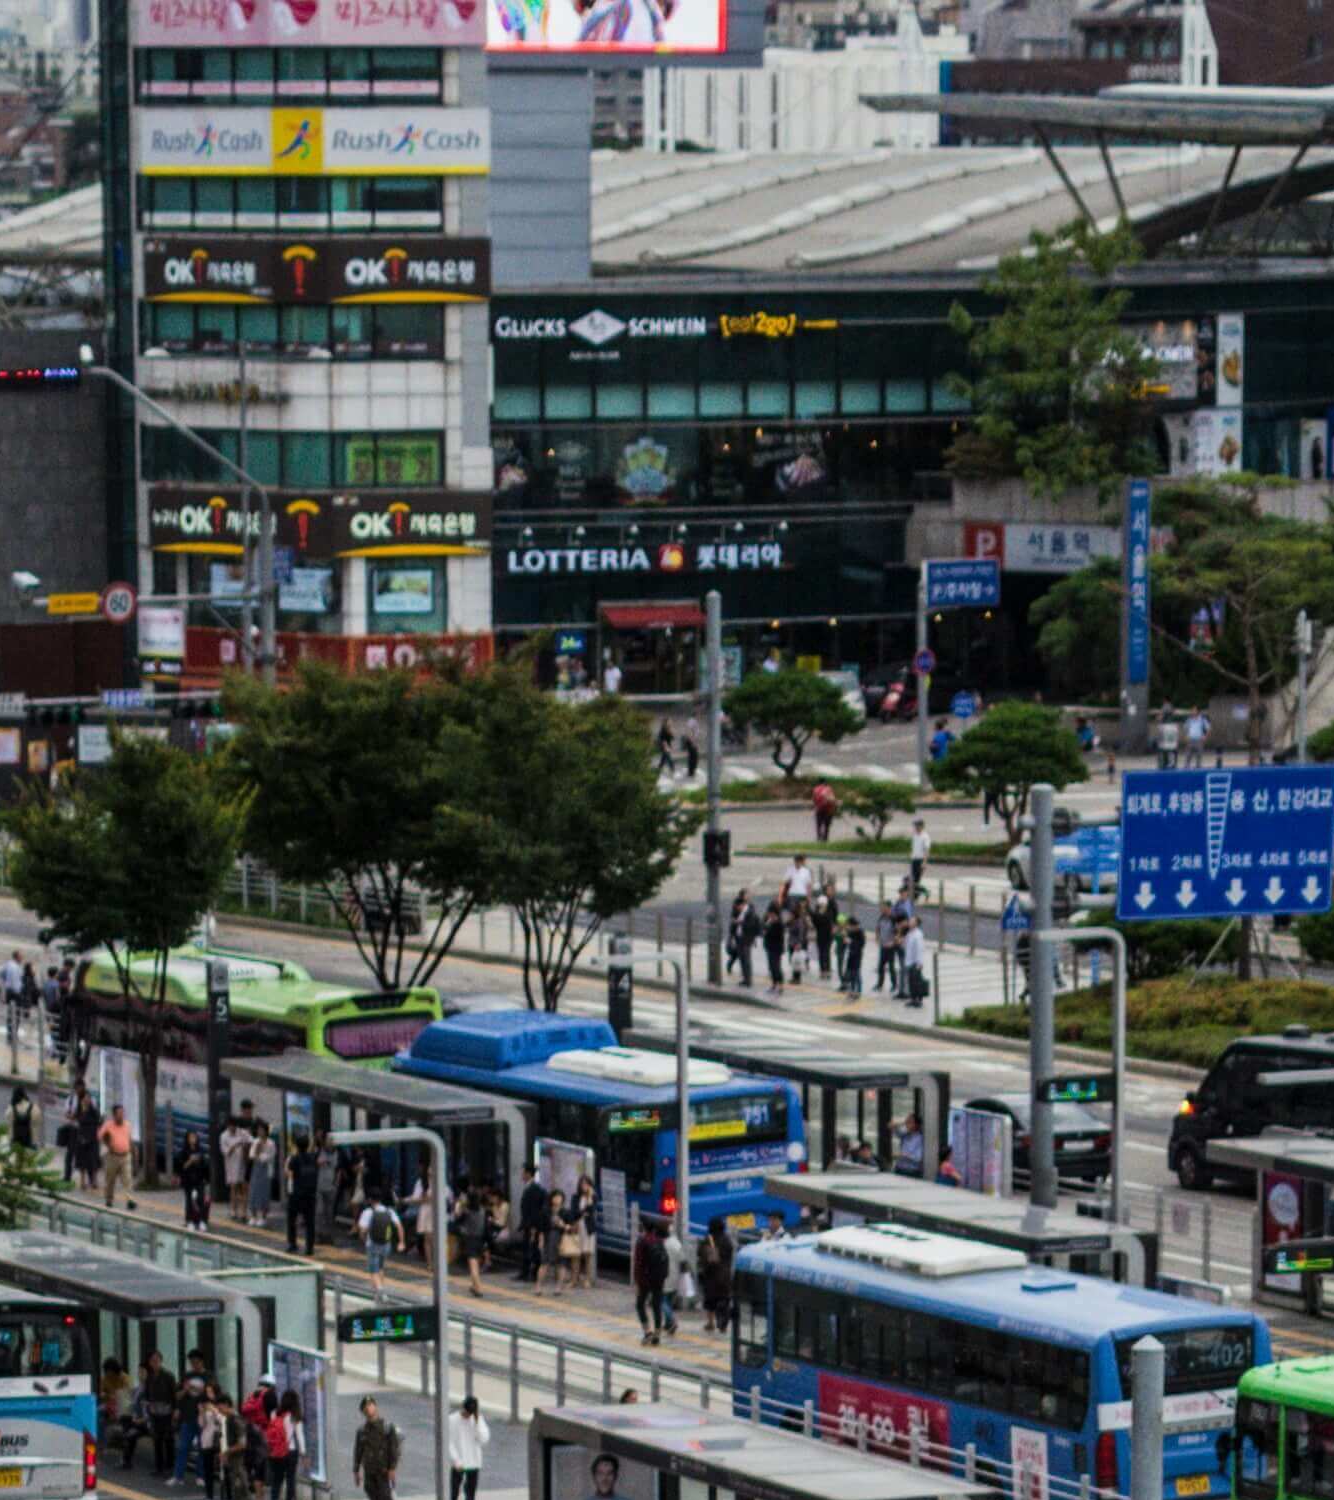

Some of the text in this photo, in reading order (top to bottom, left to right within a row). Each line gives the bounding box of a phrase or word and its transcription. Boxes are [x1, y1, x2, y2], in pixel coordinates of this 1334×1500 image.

[151, 129, 262, 152] Rush Cash
[331, 128, 481, 152] Rush Cash
[406, 259, 475, 285] 저축은행
[628, 316, 707, 337] SCHWEIN
[410, 513, 475, 537] 저축은행
[1027, 530, 1090, 554] 서울역
[507, 548, 651, 572] LOTTERIA
[697, 543, 782, 570] 롯데리아
[1171, 854, 1203, 871] 2차로
[1221, 852, 1253, 869] 3차로
[1259, 851, 1290, 867] 4차로
[1297, 849, 1329, 867] 5차로
[215, 997, 229, 1018] 5
